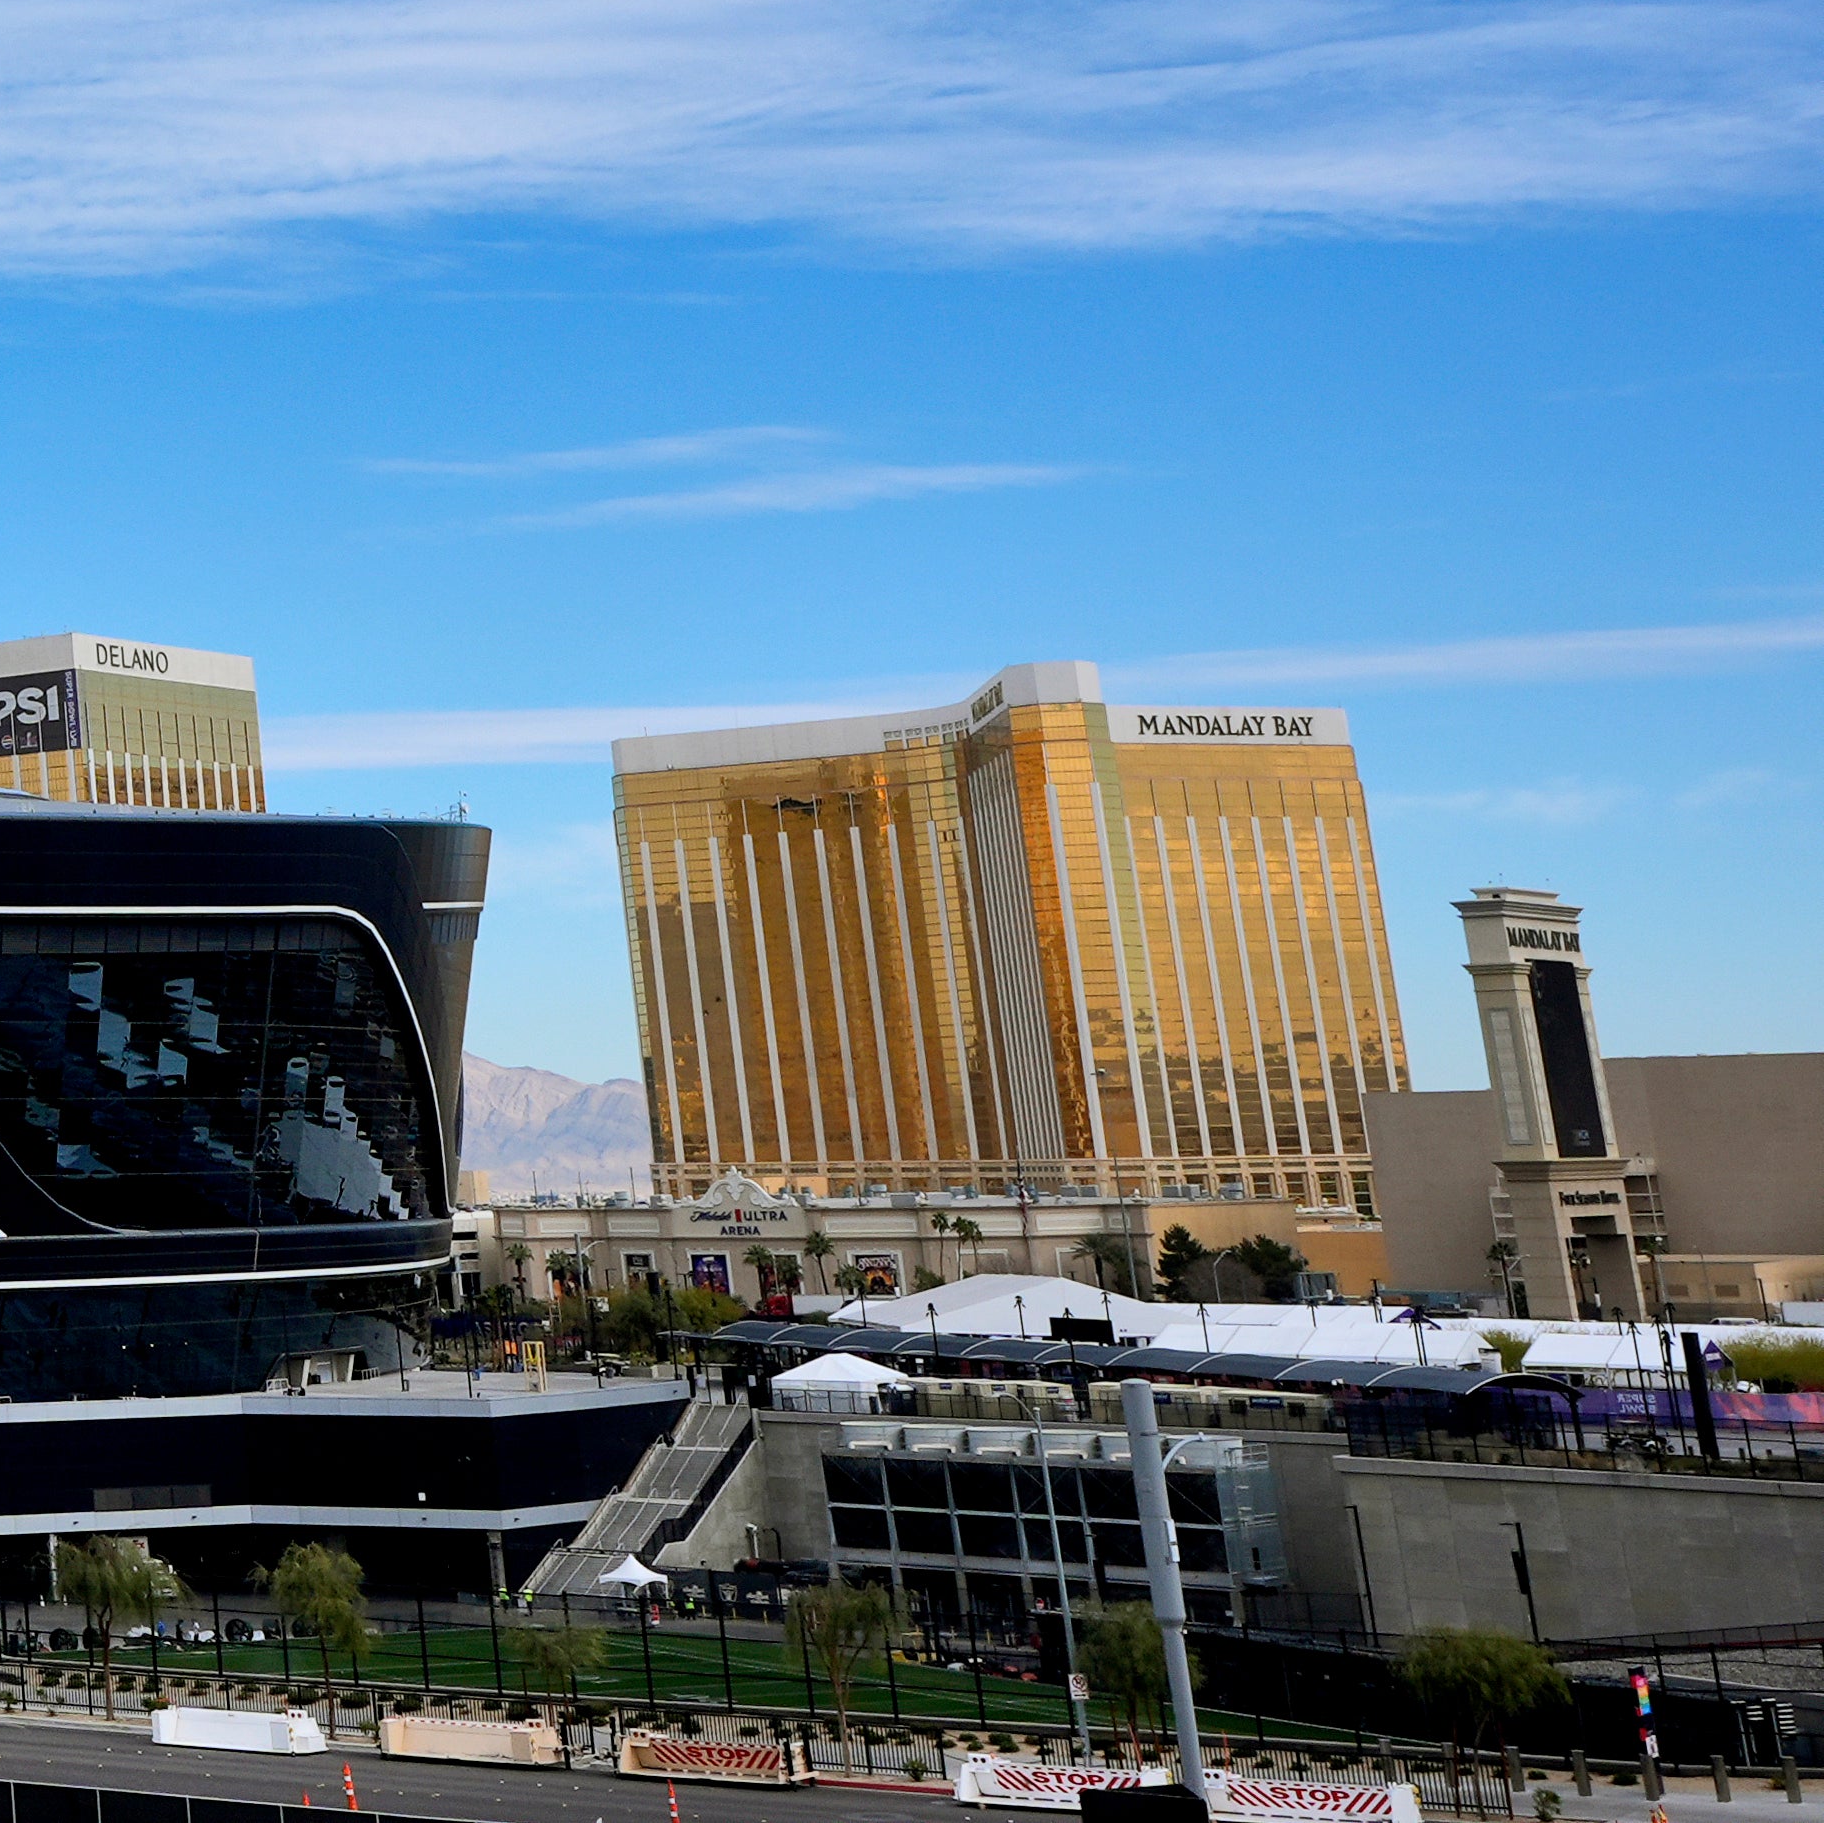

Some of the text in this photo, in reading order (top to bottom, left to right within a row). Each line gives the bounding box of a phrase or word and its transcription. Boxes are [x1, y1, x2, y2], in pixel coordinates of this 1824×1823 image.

[96, 643, 168, 673] DELANO
[1137, 714, 1313, 737] MANDALAY BAY
[744, 1211, 788, 1221] ULTRA
[721, 1226, 761, 1236] ARENA
[686, 1746, 751, 1760] STOP
[1031, 1770, 1105, 1787] STOP
[1270, 1786, 1350, 1803] STOP
